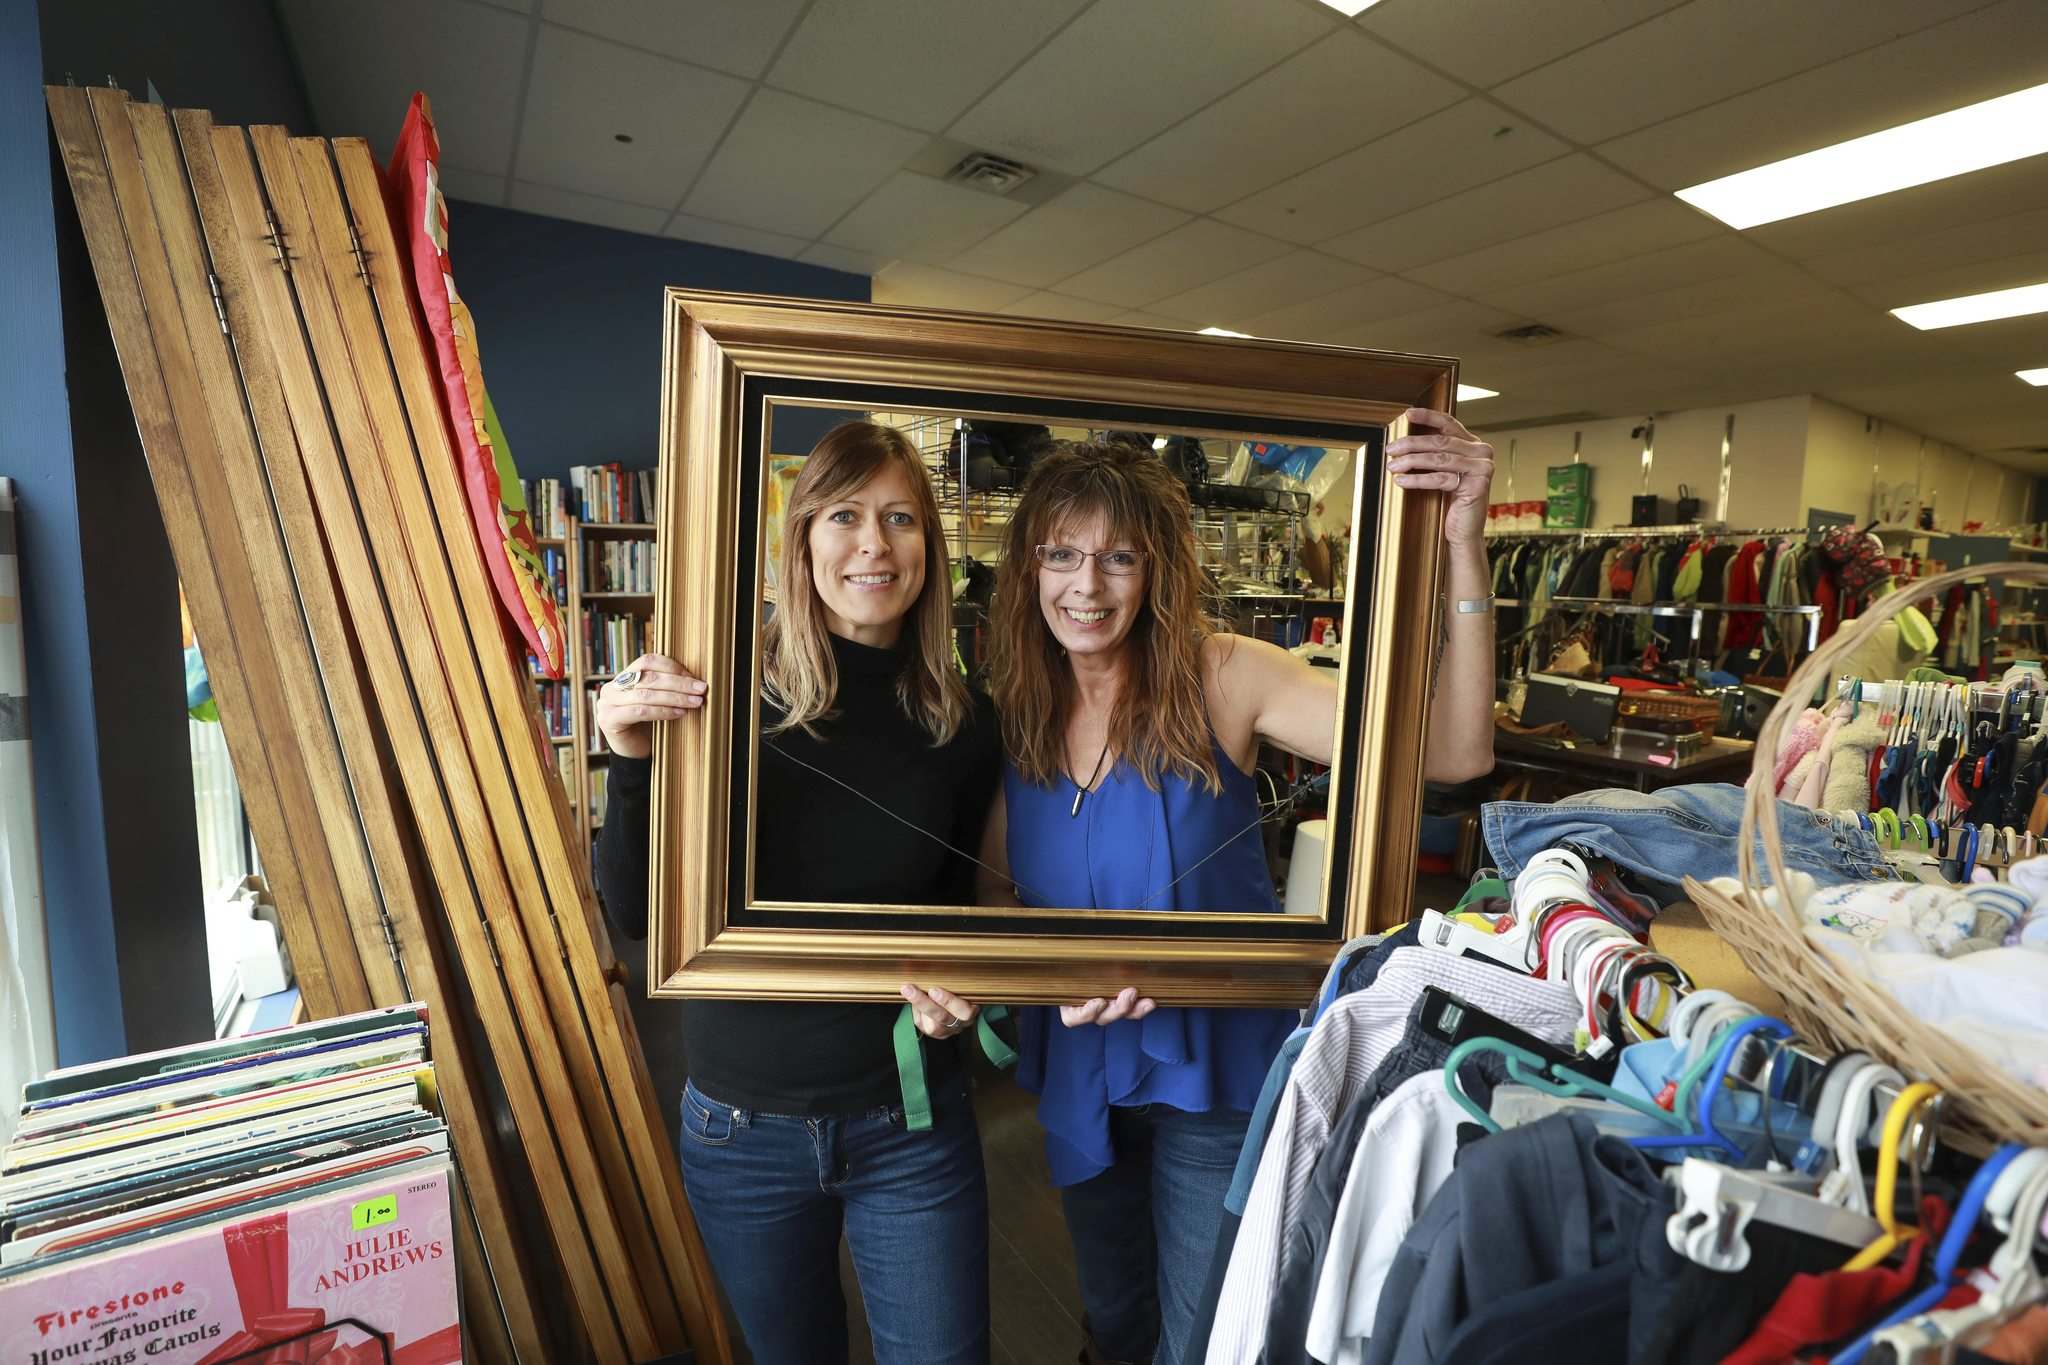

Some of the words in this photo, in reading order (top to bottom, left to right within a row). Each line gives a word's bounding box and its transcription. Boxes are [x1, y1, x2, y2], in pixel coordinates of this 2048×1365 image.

[407, 1182, 437, 1194] STEREO
[366, 1207, 391, 1224] 1.00
[344, 1228, 412, 1263] JULIE
[314, 1241, 443, 1293] ANDREWS
[33, 1280, 186, 1337] Firestone
[29, 1337, 93, 1365] Your
[94, 1307, 198, 1353] Favorite
[143, 1321, 222, 1356] Carols
